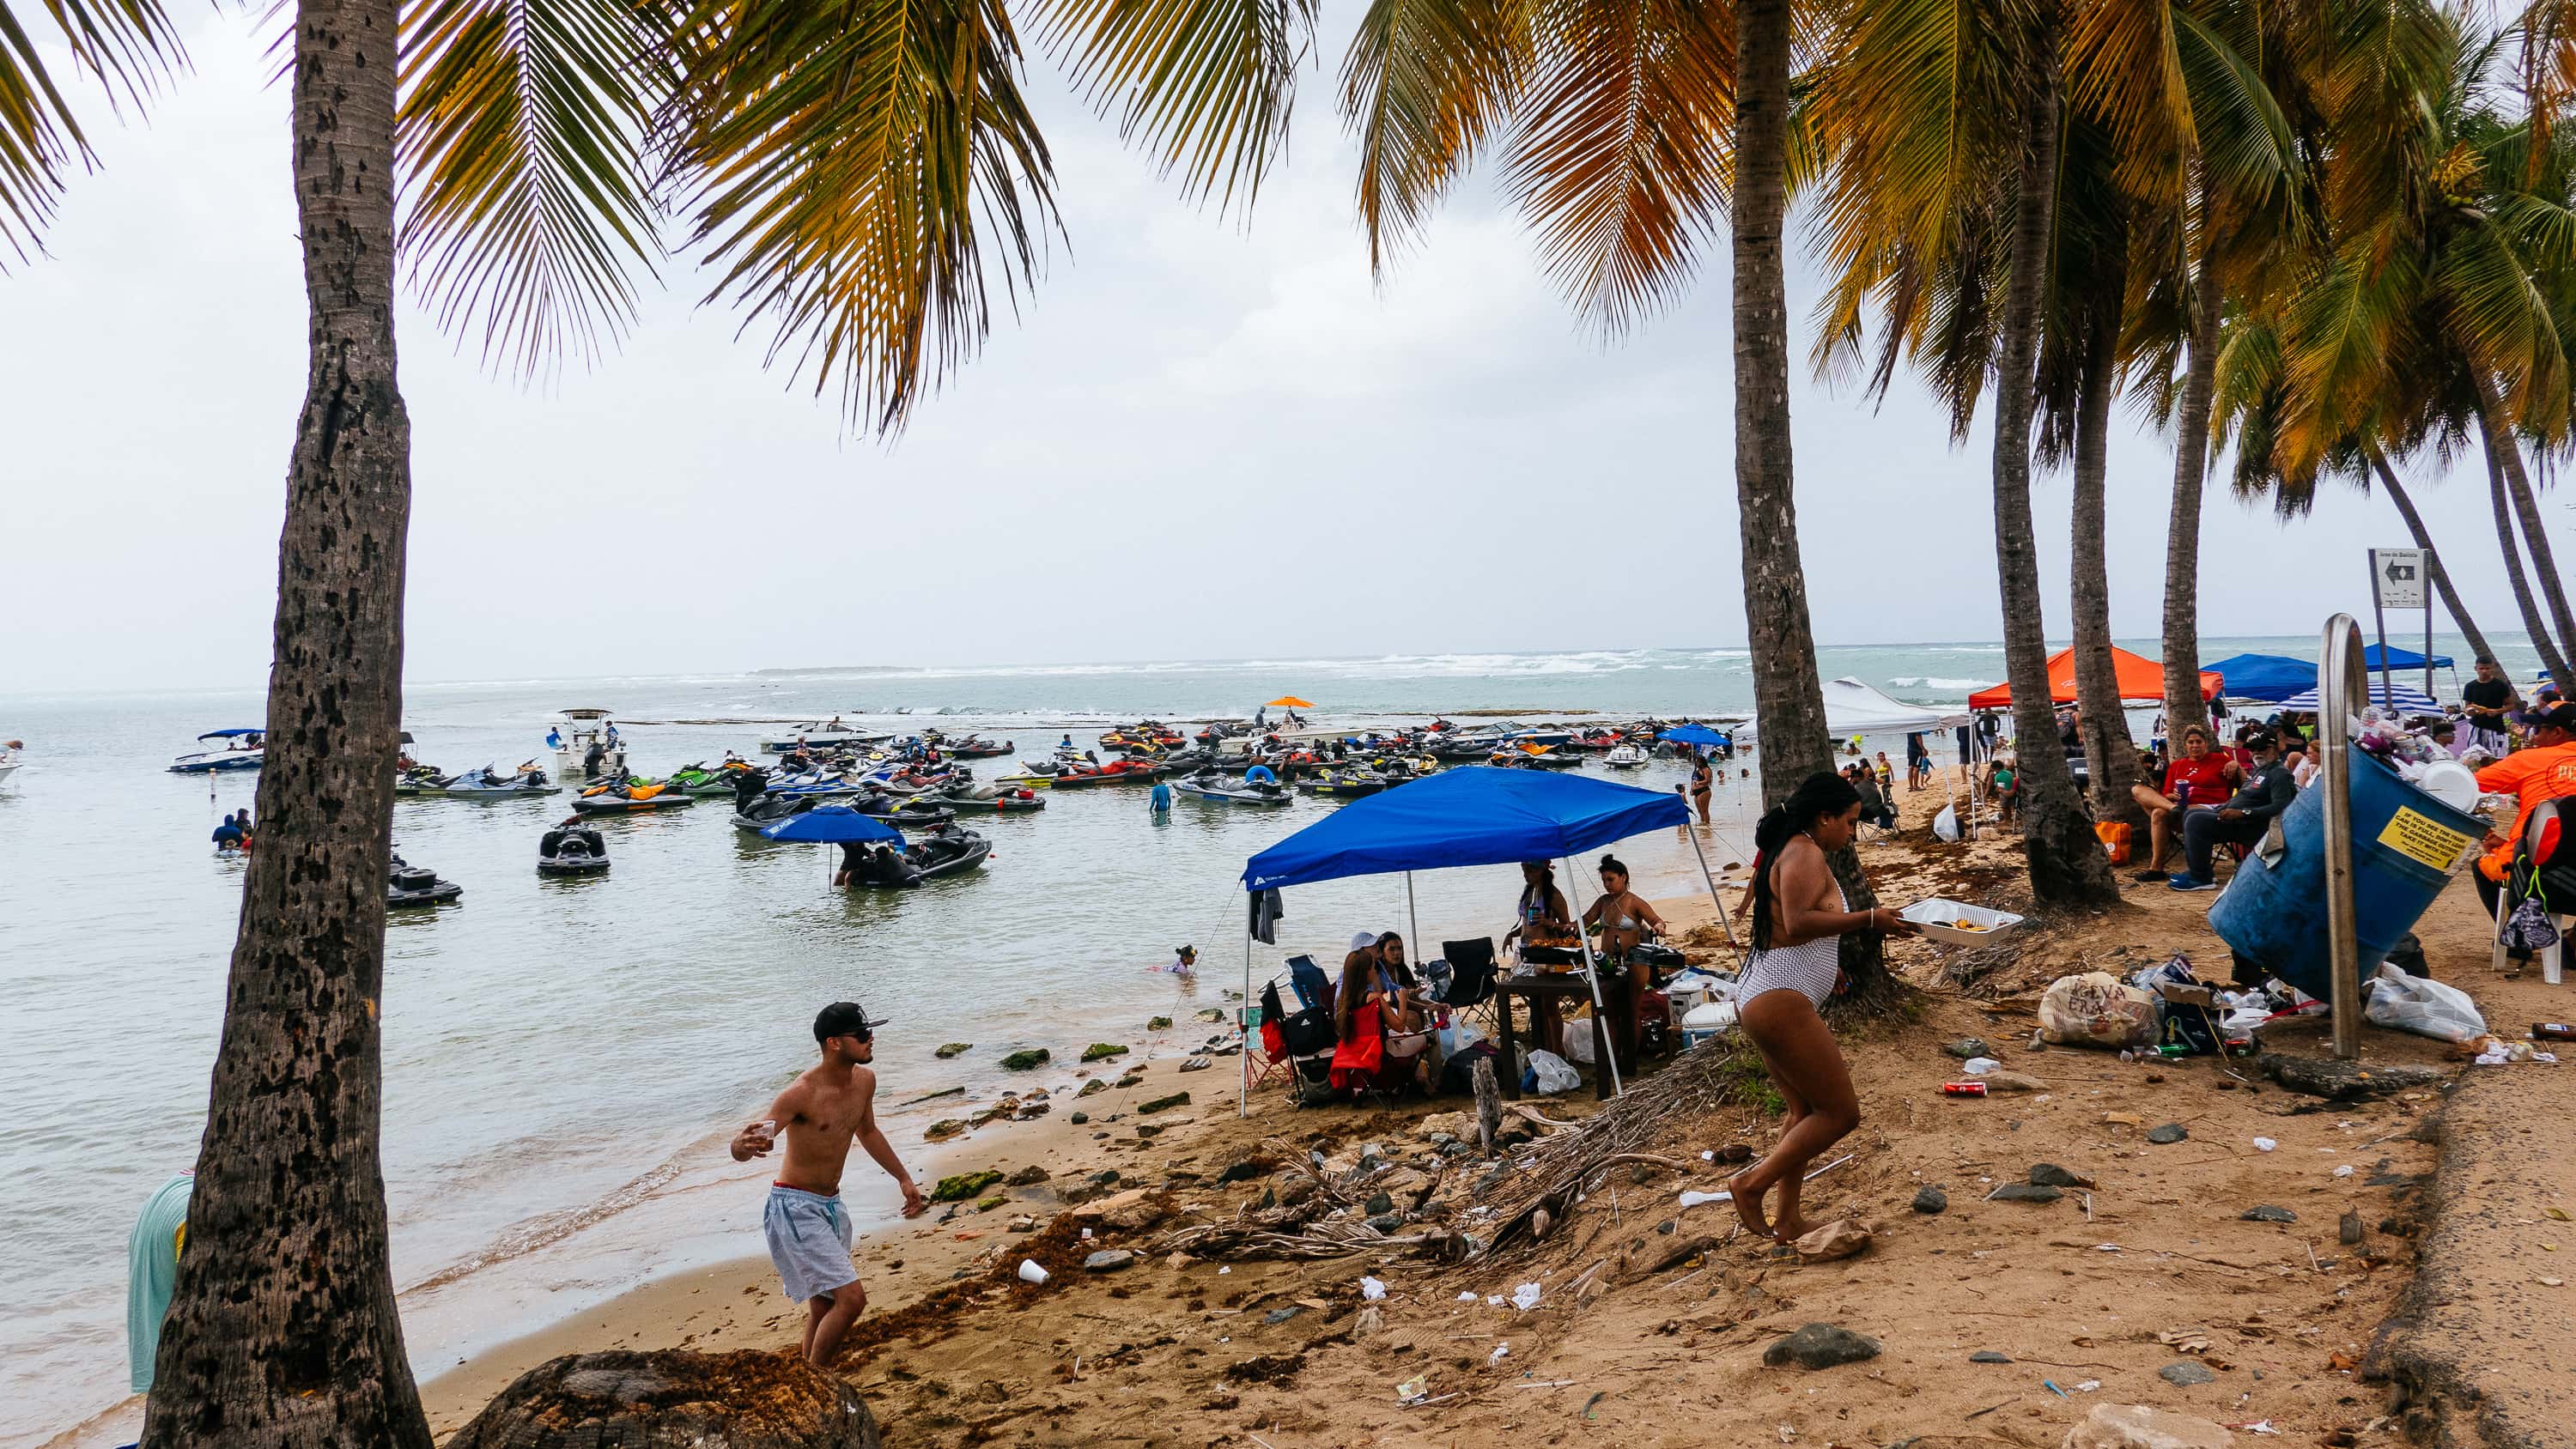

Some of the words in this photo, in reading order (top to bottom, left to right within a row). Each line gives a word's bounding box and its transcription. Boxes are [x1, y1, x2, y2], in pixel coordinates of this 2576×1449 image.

[2396, 815, 2409, 824] CAN
[2413, 816, 2427, 825] YOU
[2427, 823, 2439, 832] SEE
[2396, 822, 2409, 831] THE
[2409, 829, 2439, 846] GARBAGE
[2400, 831, 2416, 841] TAKE
[2425, 844, 2439, 852] WITH
[2069, 996, 2105, 1014] ERA
